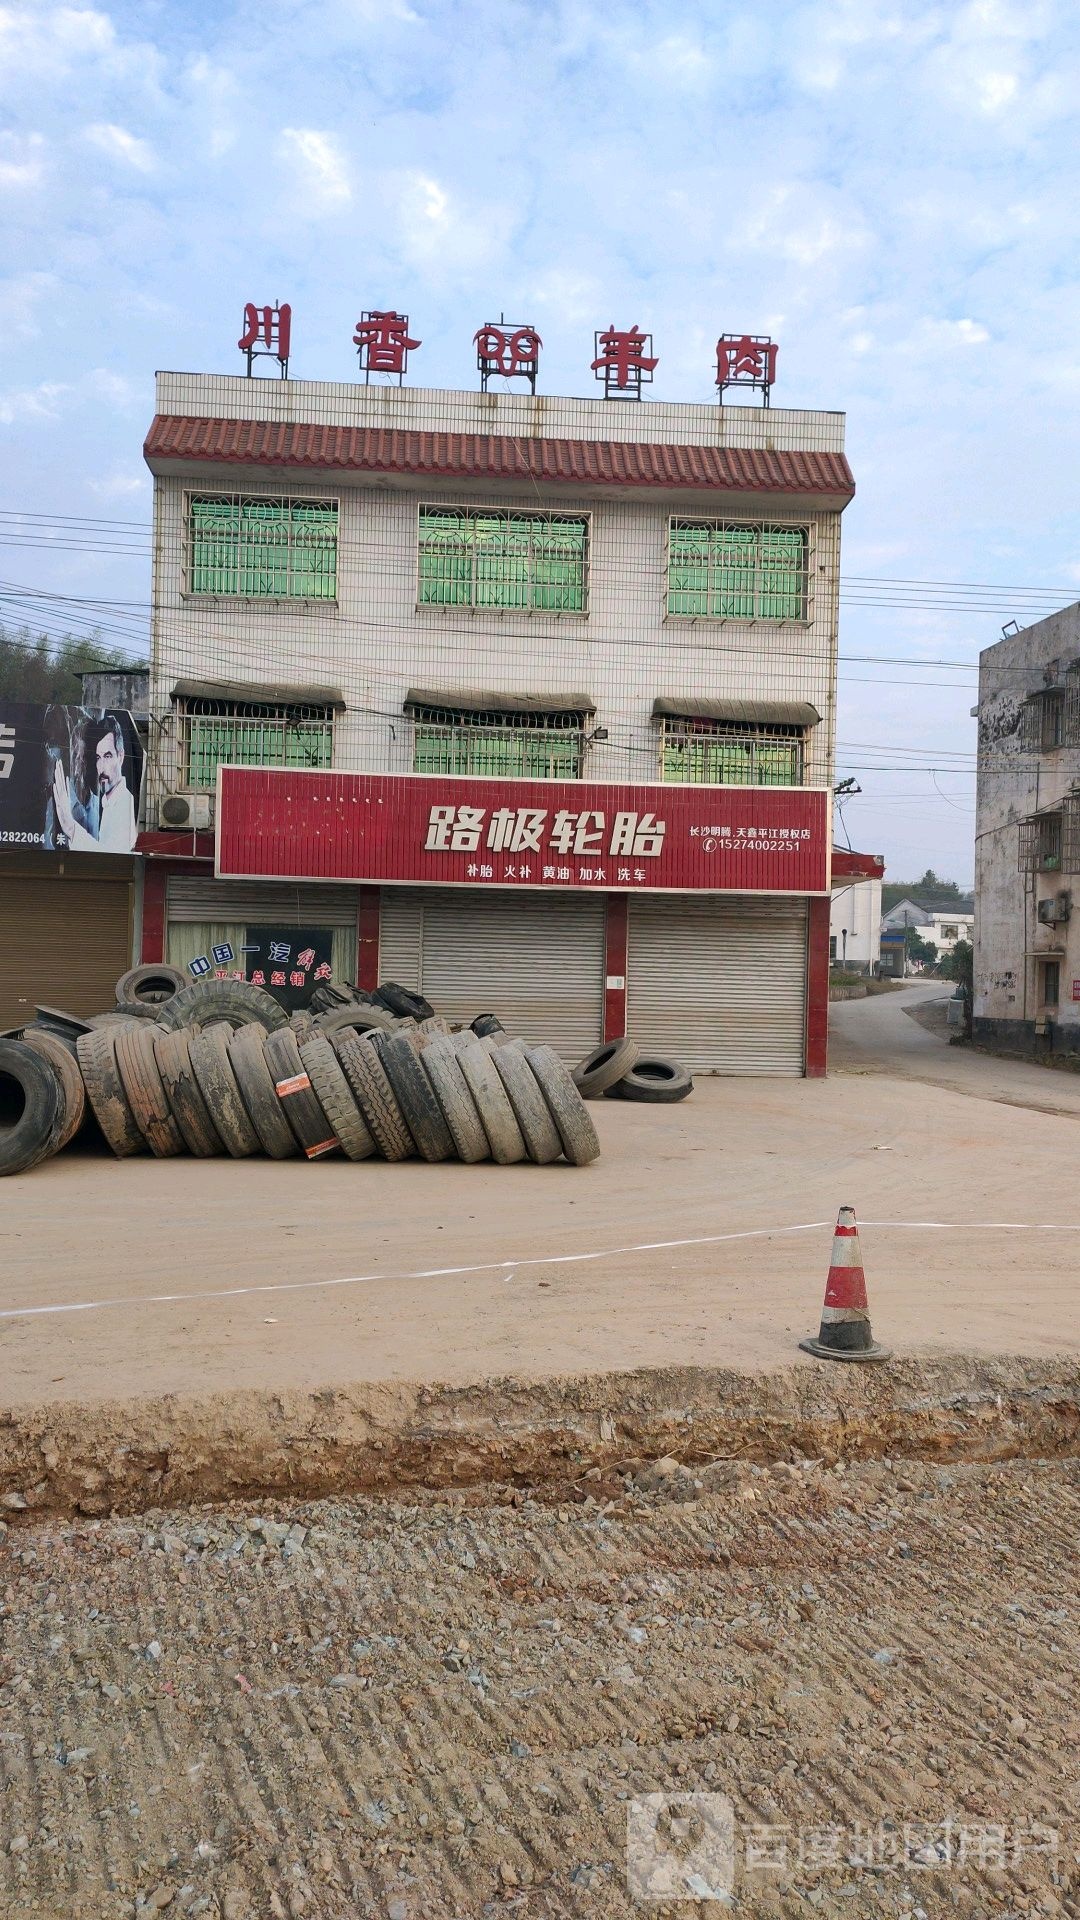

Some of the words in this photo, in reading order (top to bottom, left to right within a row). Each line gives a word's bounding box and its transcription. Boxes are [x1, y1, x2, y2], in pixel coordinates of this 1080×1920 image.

[425, 805, 666, 857] 路极轮胎
[719, 839, 800, 851] 15274002251
[467, 864, 494, 878] 补胎
[503, 865, 532, 878] 火补
[542, 866, 570, 880] 黄油
[579, 867, 606, 881] 加水
[617, 868, 646, 881] 洗车
